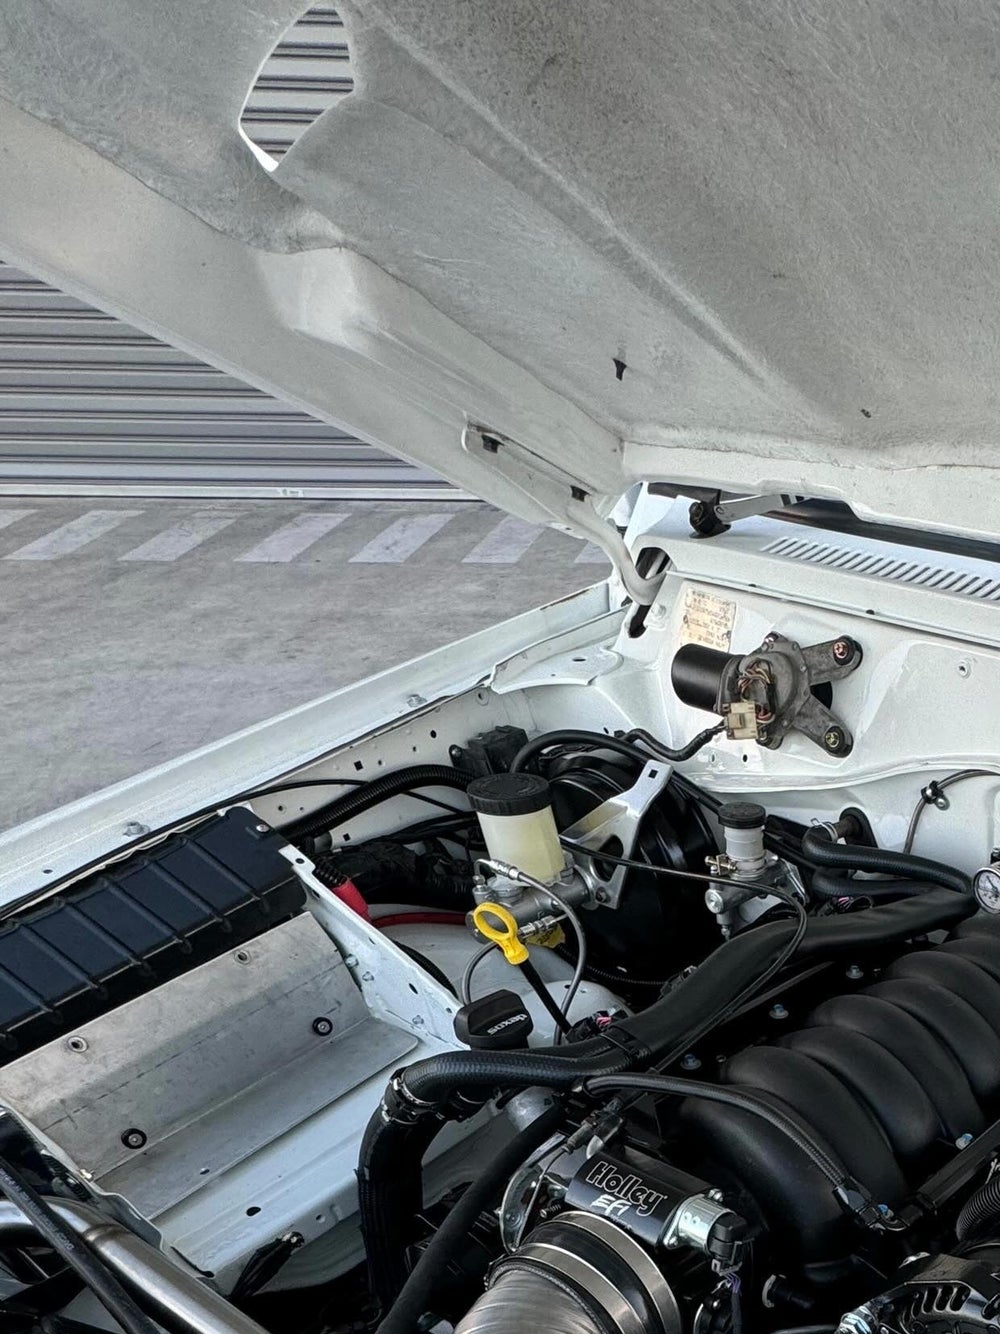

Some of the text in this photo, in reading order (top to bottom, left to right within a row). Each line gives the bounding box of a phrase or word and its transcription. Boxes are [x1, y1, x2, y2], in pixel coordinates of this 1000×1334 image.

[487, 1013, 527, 1035] dexos
[586, 1161, 664, 1217] Holley
[590, 1194, 632, 1216] EFI
